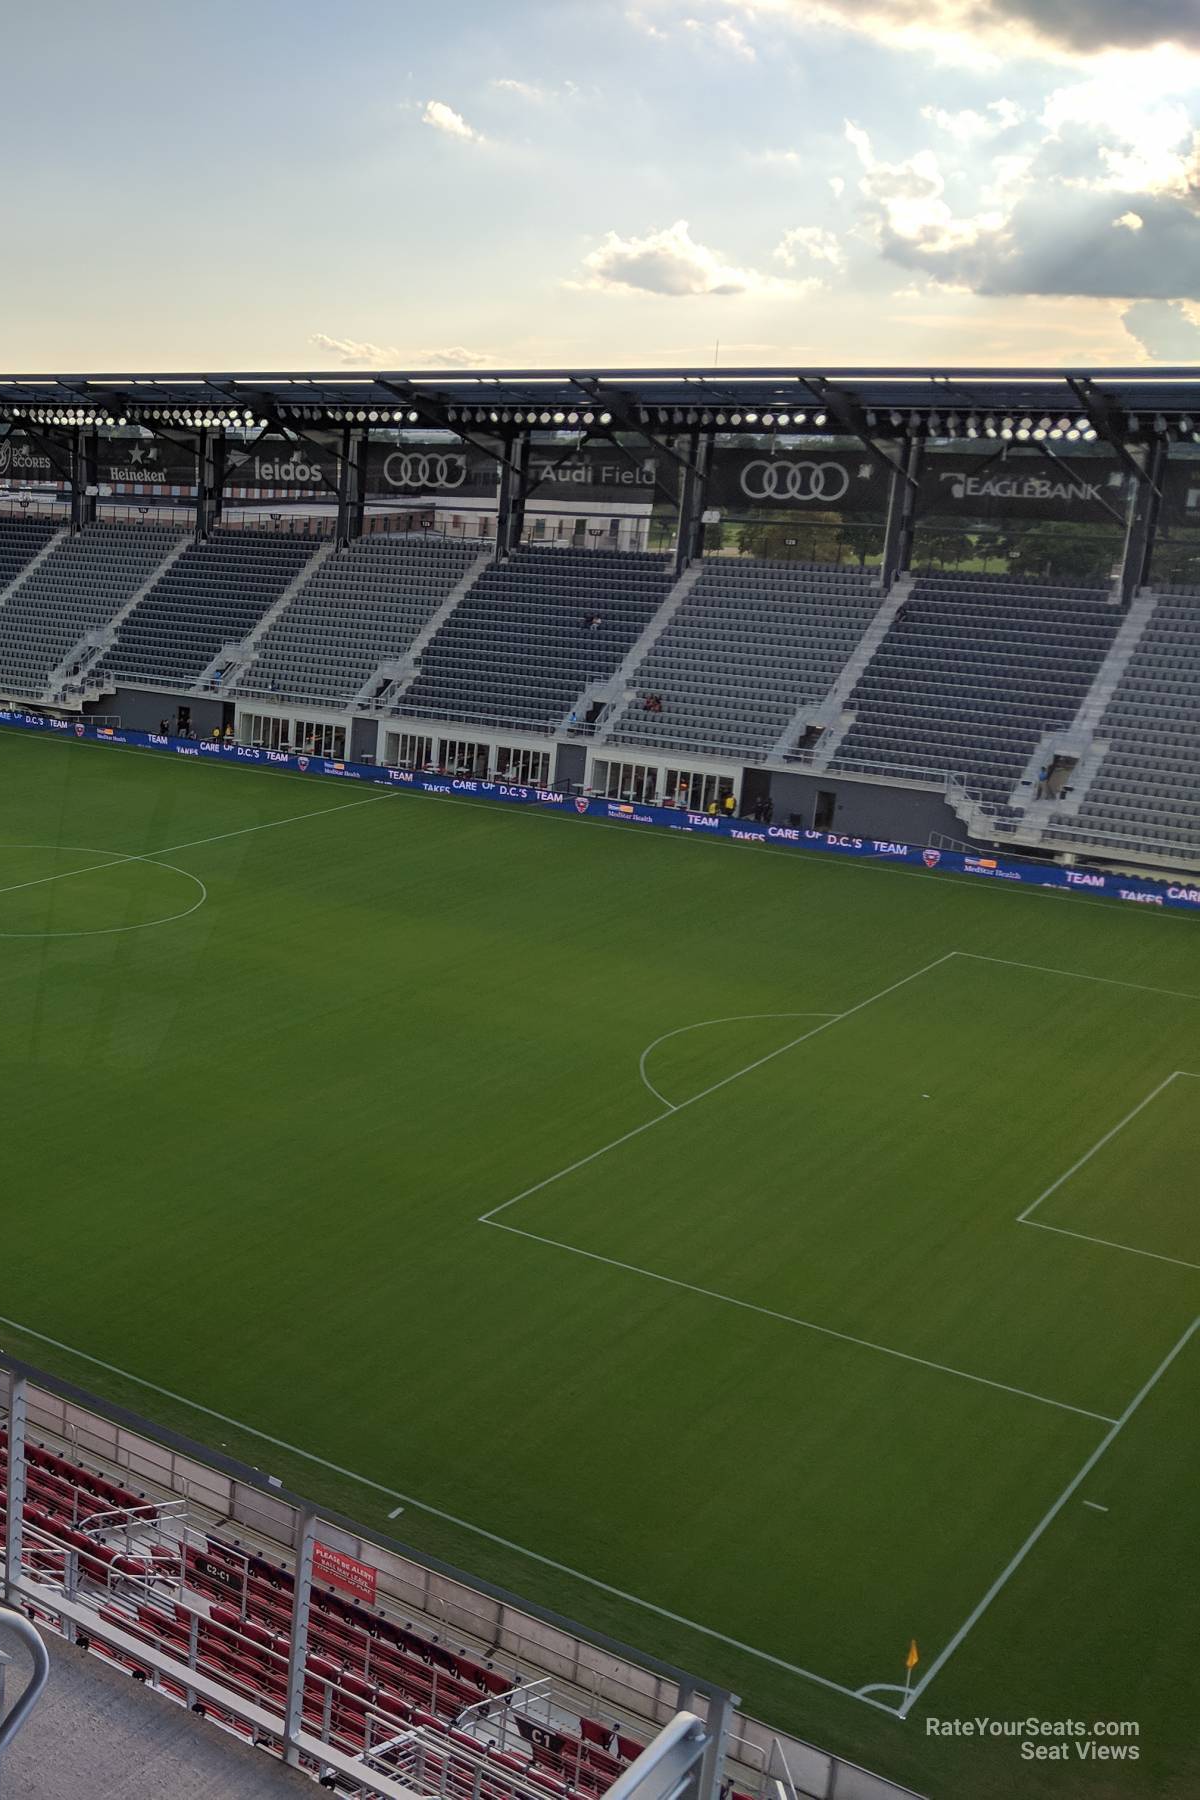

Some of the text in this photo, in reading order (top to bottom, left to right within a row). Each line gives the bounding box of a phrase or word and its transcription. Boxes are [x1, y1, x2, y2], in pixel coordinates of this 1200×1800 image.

[12, 457, 51, 468] SCORES
[254, 456, 322, 482] leidos
[110, 467, 164, 482] Heineken
[540, 465, 656, 484] Audi Field
[965, 477, 1101, 500] EAGLEBANK
[25, 715, 44, 727] D.C.'S
[50, 719, 67, 729] TEAM
[148, 734, 167, 745] TEAM
[200, 742, 220, 753] CARE
[237, 747, 260, 759] D.C.'S
[266, 751, 288, 762] TEAM
[388, 770, 413, 782] TEAM
[453, 780, 477, 791] CARE
[500, 785, 527, 798] D.C.'S
[535, 790, 563, 803] TEAM
[633, 813, 653, 823] Health
[687, 814, 719, 827] TEAM
[768, 827, 799, 840] CARE
[828, 834, 862, 849] D.C.'S
[873, 841, 907, 855] TEAM
[964, 865, 1021, 880] MedStar Health
[1066, 871, 1105, 887] TEAM
[1167, 887, 1200, 902] CAR
[206, 1563, 230, 1582] C2-C1
[316, 1549, 340, 1565] PLEASE
[341, 1562, 350, 1570] BE
[351, 1564, 374, 1582] ALERT!
[531, 1729, 550, 1748] C1
